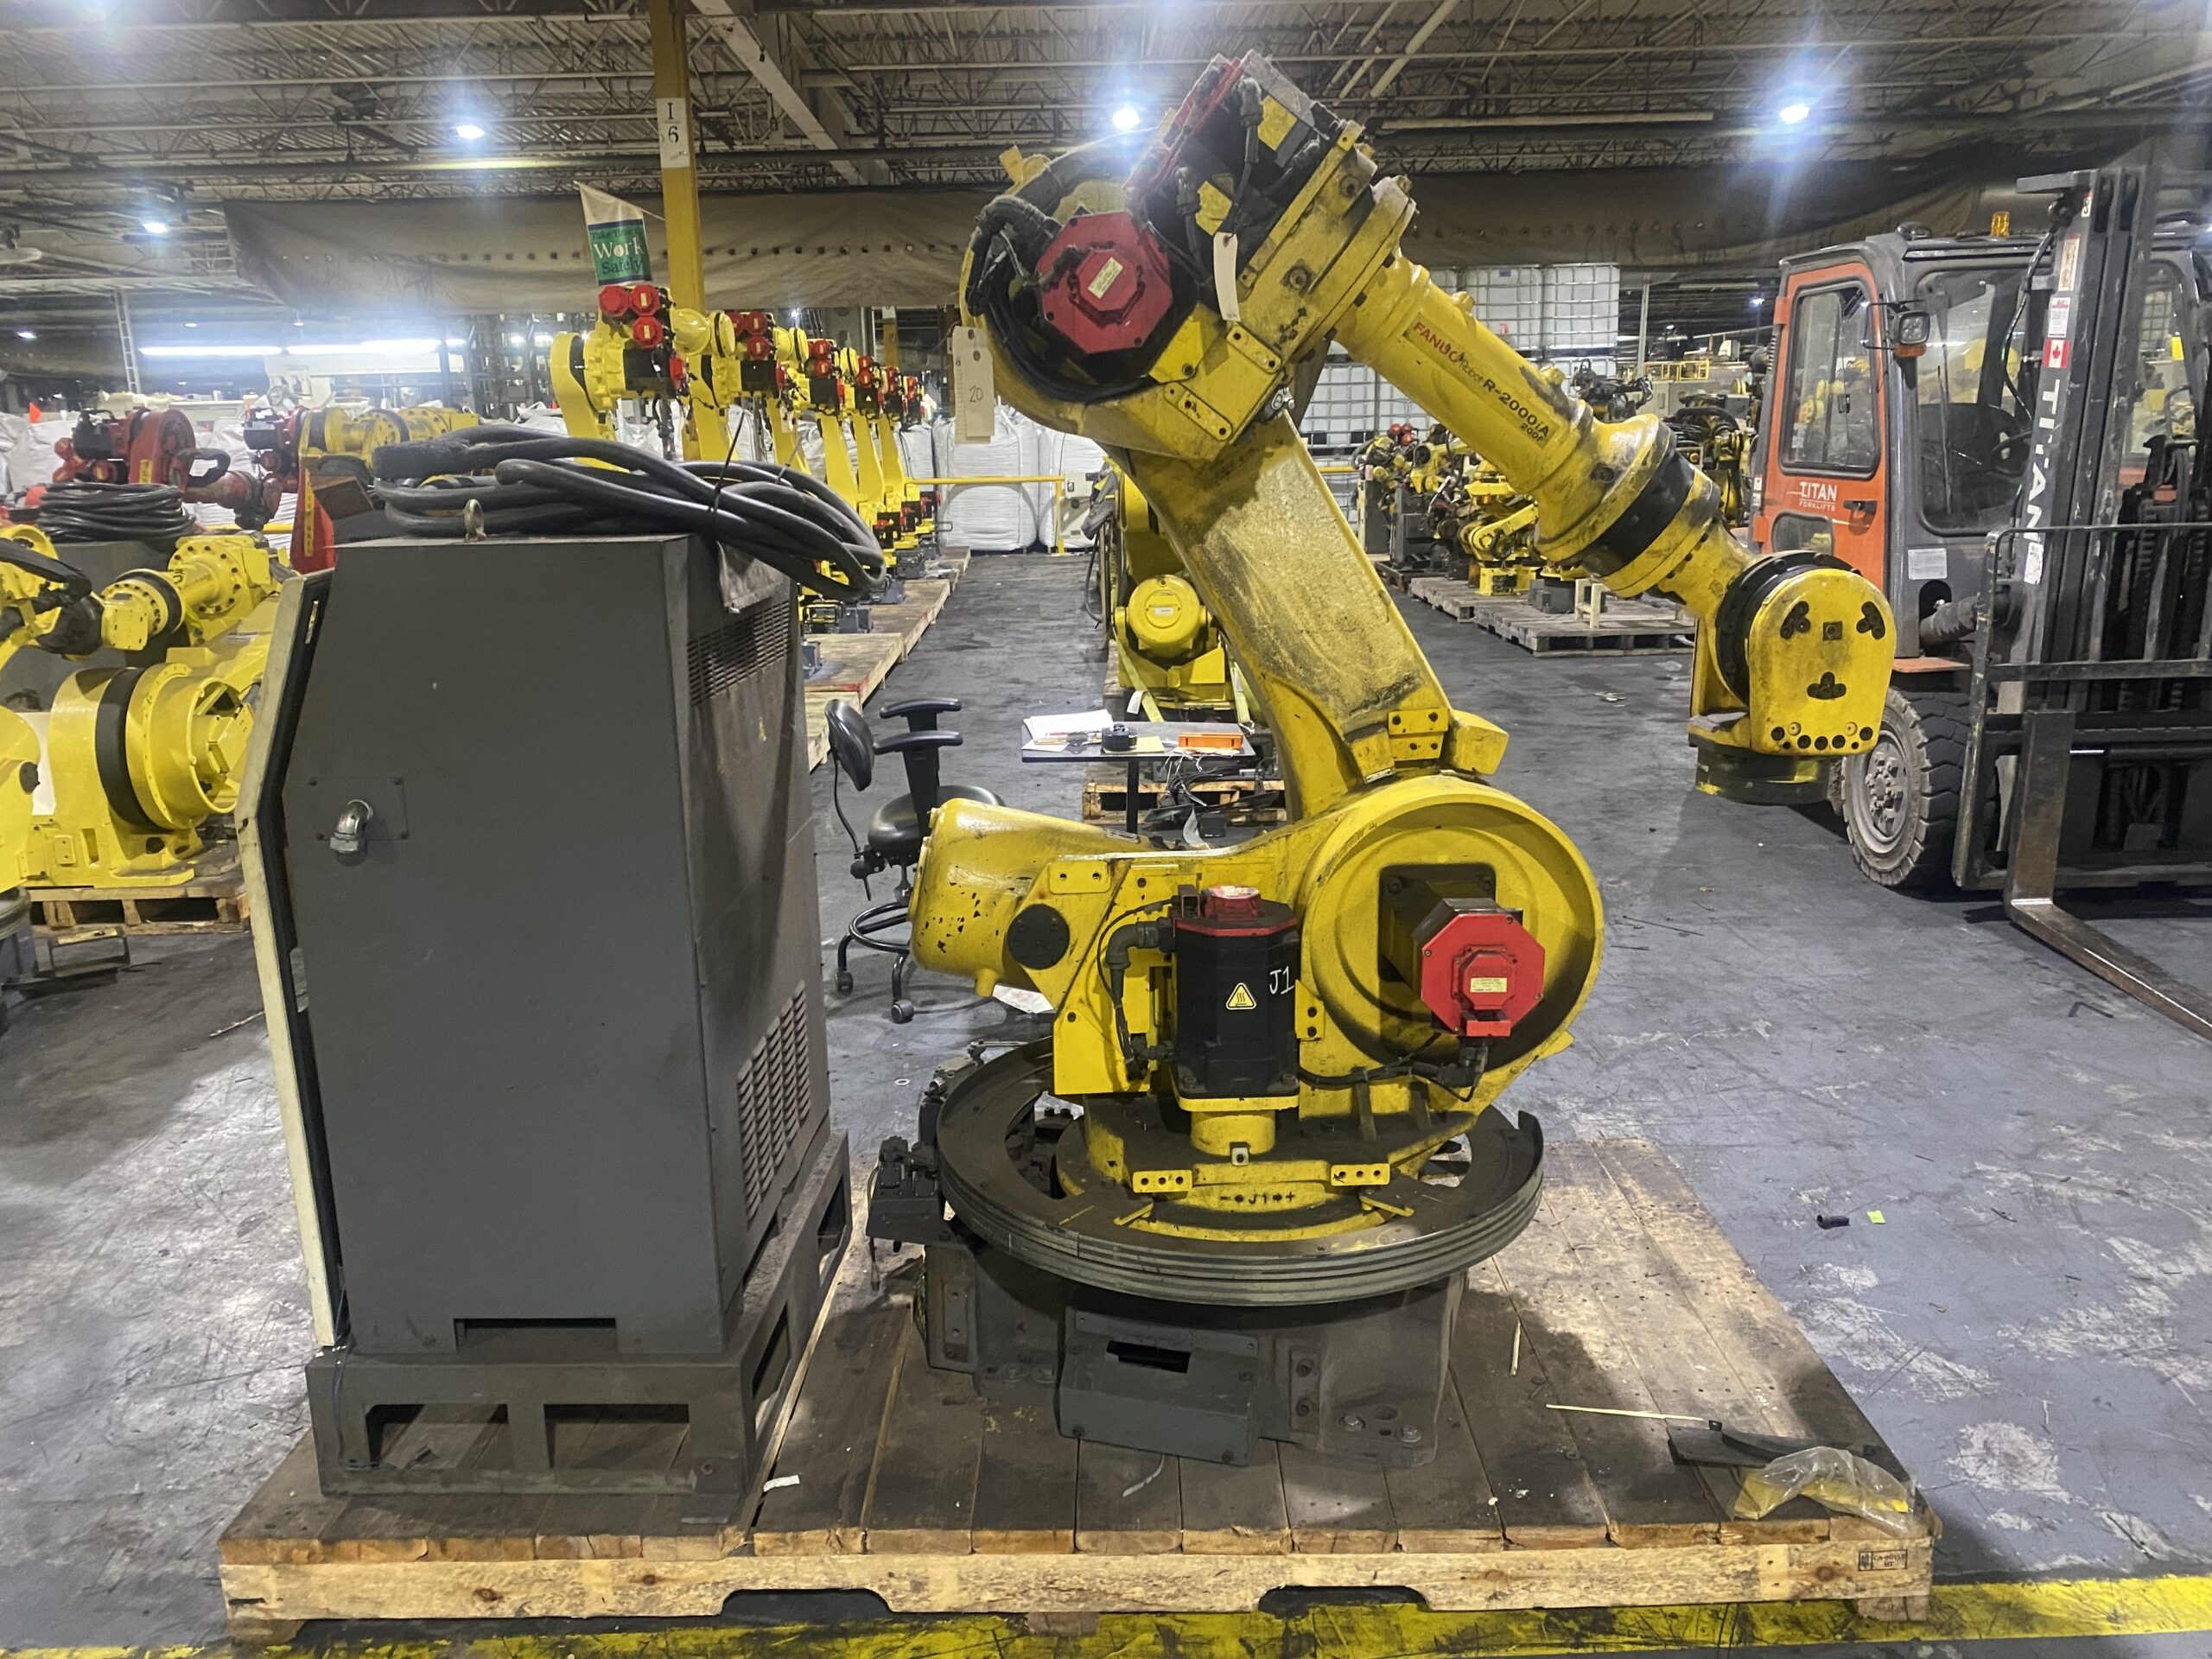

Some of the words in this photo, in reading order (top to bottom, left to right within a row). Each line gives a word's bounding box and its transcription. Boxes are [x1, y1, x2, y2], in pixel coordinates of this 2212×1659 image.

[668, 125, 679, 143] 6
[593, 237, 645, 259] Work
[601, 257, 642, 275] Safely
[1413, 321, 1460, 363] FANUC
[1482, 378, 1550, 438] R-2000iA
[969, 385, 983, 403] 20
[1520, 423, 1546, 443] 200F
[1799, 481, 1838, 501] TITAN
[1269, 966, 1294, 995] J1
